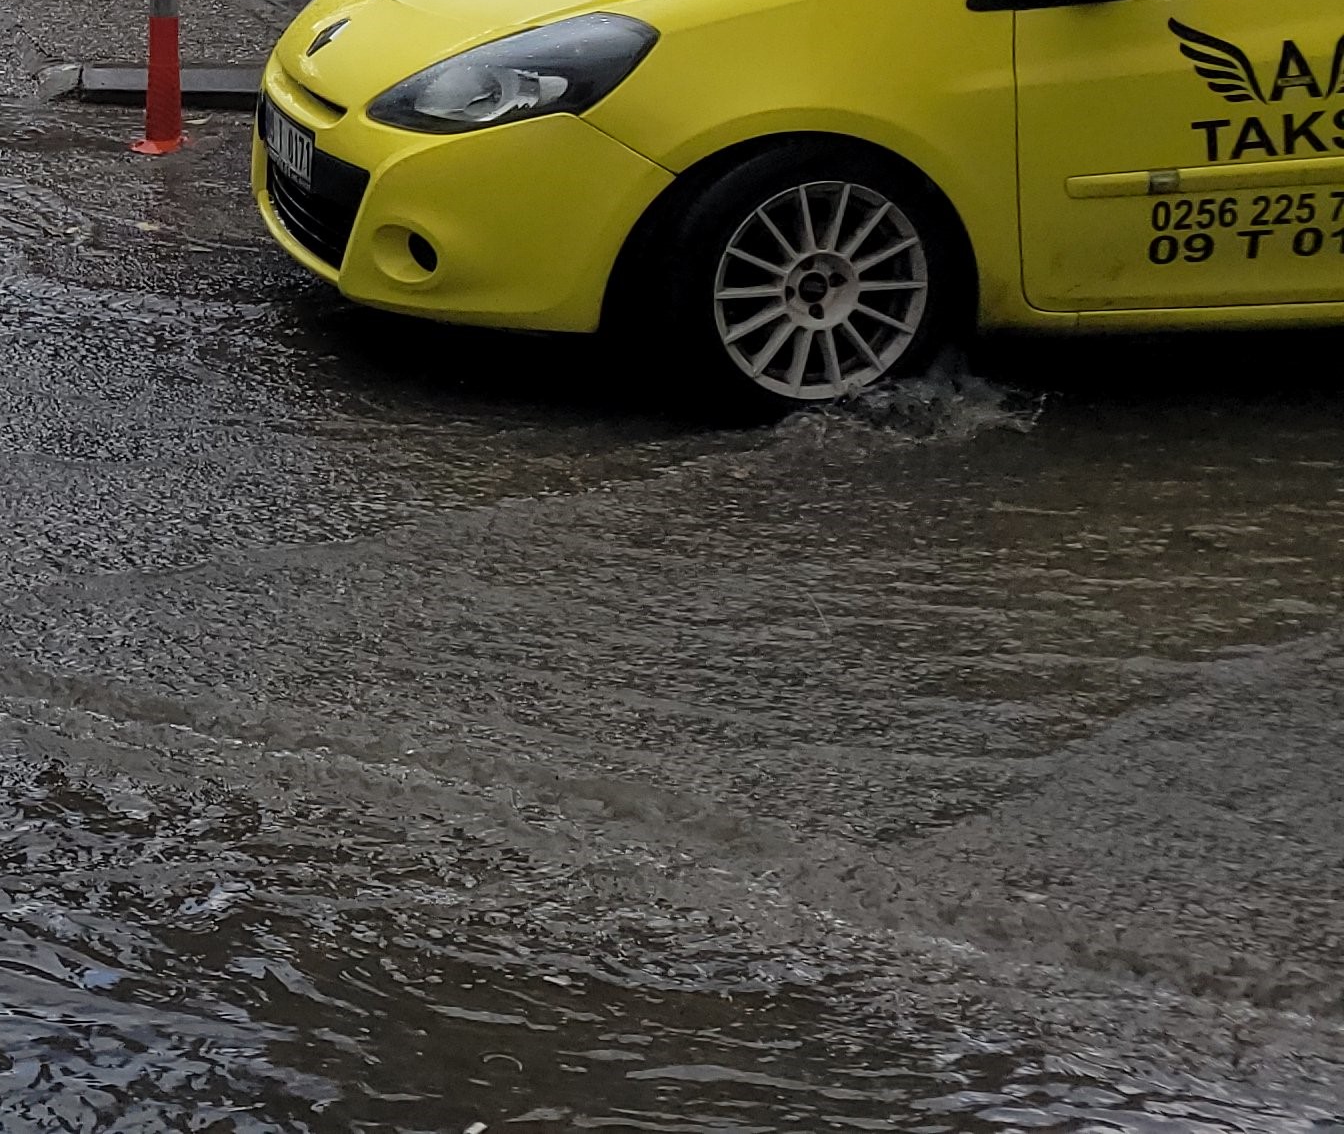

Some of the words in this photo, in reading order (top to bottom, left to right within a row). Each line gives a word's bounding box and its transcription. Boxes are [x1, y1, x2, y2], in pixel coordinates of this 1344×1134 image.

[1151, 197, 1238, 232] 0256
[1249, 193, 1316, 226] 225
[1148, 232, 1215, 265] 09
[1236, 229, 1274, 259] T
